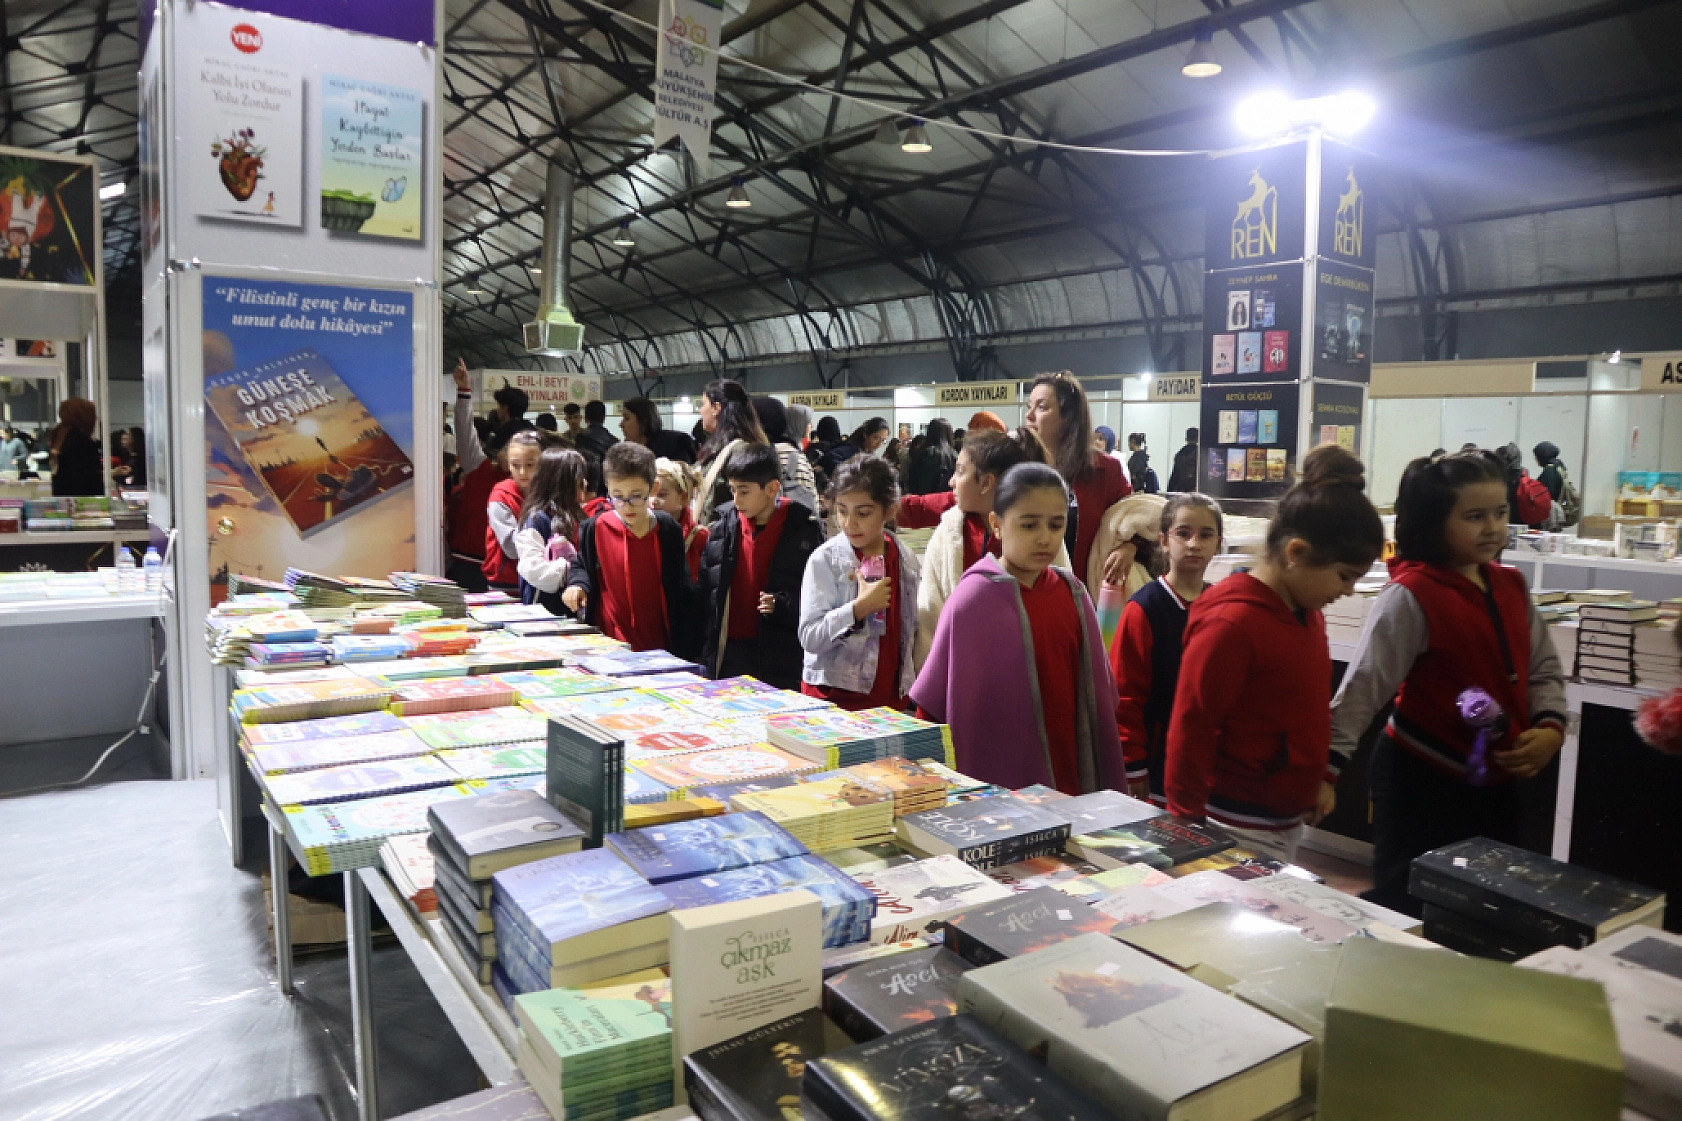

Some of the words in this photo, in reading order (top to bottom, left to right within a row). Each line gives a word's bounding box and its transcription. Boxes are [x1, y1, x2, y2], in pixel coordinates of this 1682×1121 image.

[1231, 208, 1277, 260] REN
[1334, 207, 1363, 257] REN
[300, 298, 339, 314] genç
[343, 297, 366, 312] bir
[369, 299, 406, 316] kızın
[232, 314, 276, 328] umut
[279, 314, 315, 330] dolu
[237, 368, 315, 406] GÜNEŞE
[544, 377, 569, 388] BEYT
[971, 385, 1008, 400] YAYINLARI
[245, 386, 336, 429] KOŞMAK
[963, 842, 997, 862] KÖLE
[736, 957, 776, 985] aşk
